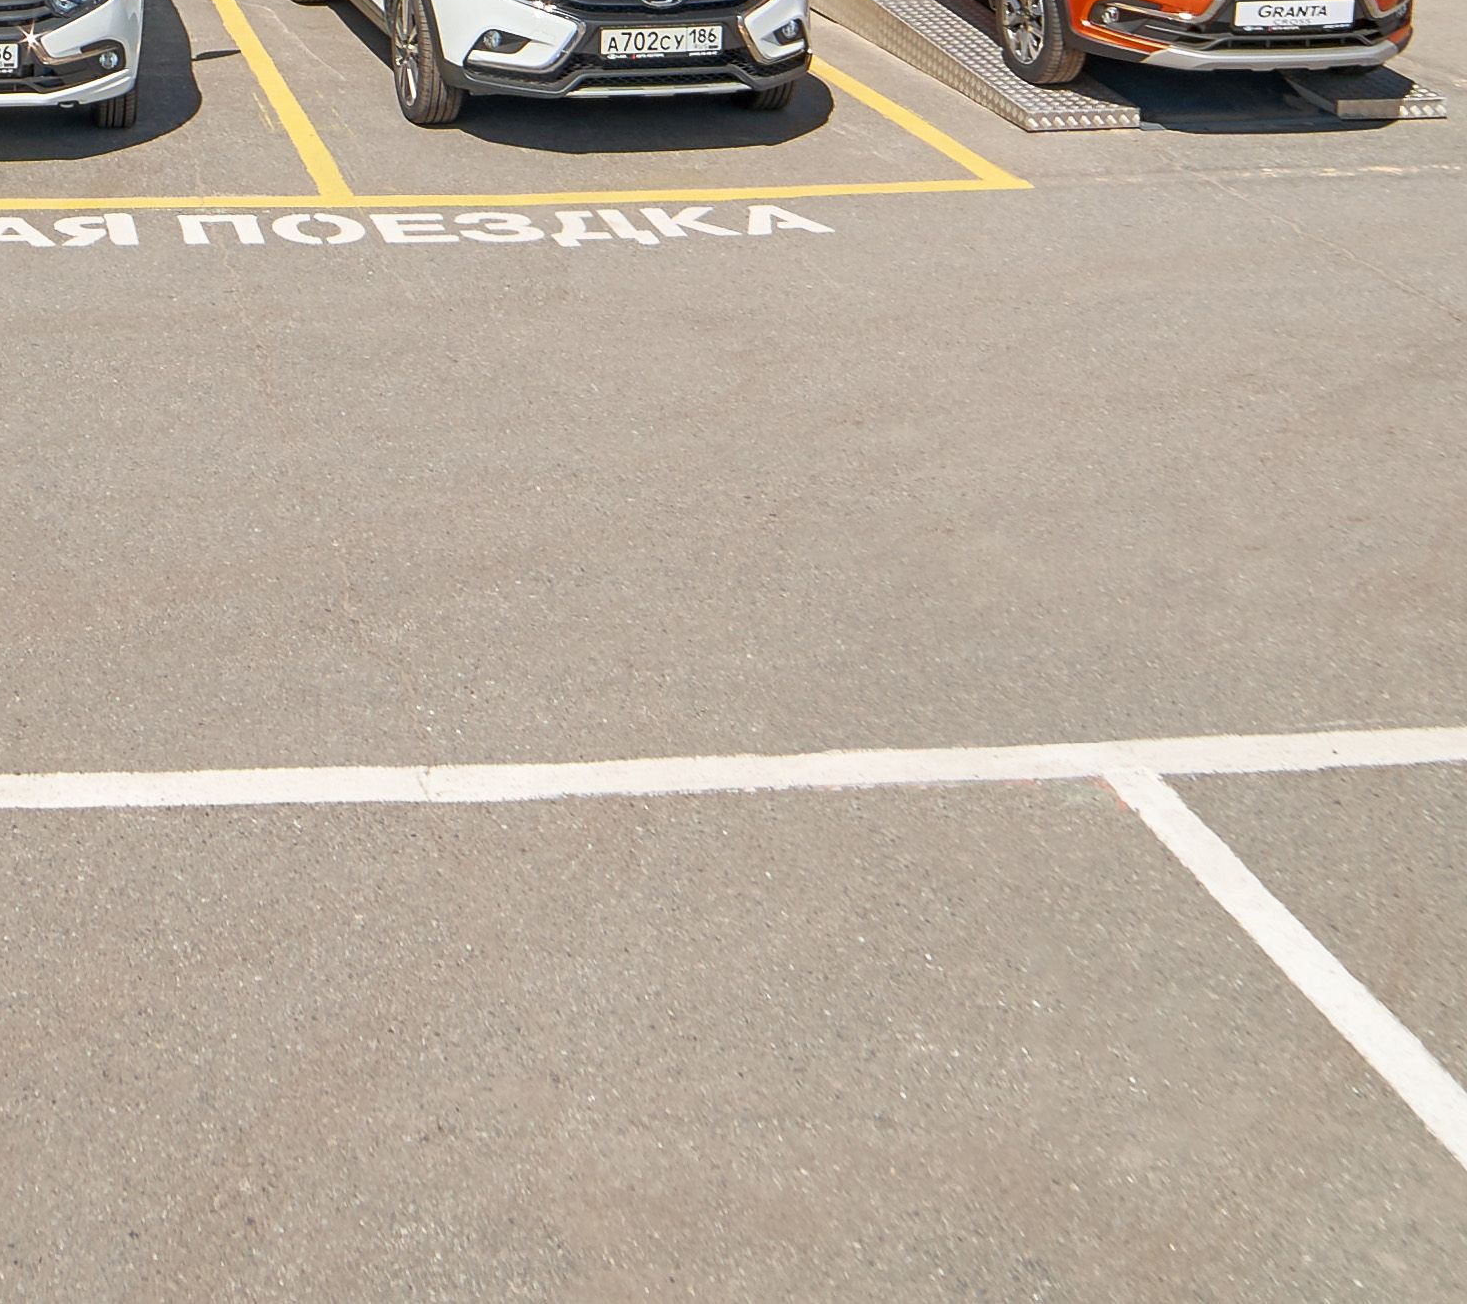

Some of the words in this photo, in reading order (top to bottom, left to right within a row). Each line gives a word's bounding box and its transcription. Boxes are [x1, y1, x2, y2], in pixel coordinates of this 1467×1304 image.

[1258, 5, 1327, 18] GRANTA
[608, 32, 684, 51] А702СУ
[689, 28, 717, 43] 186
[176, 204, 836, 247] ПОЕЗДКА
